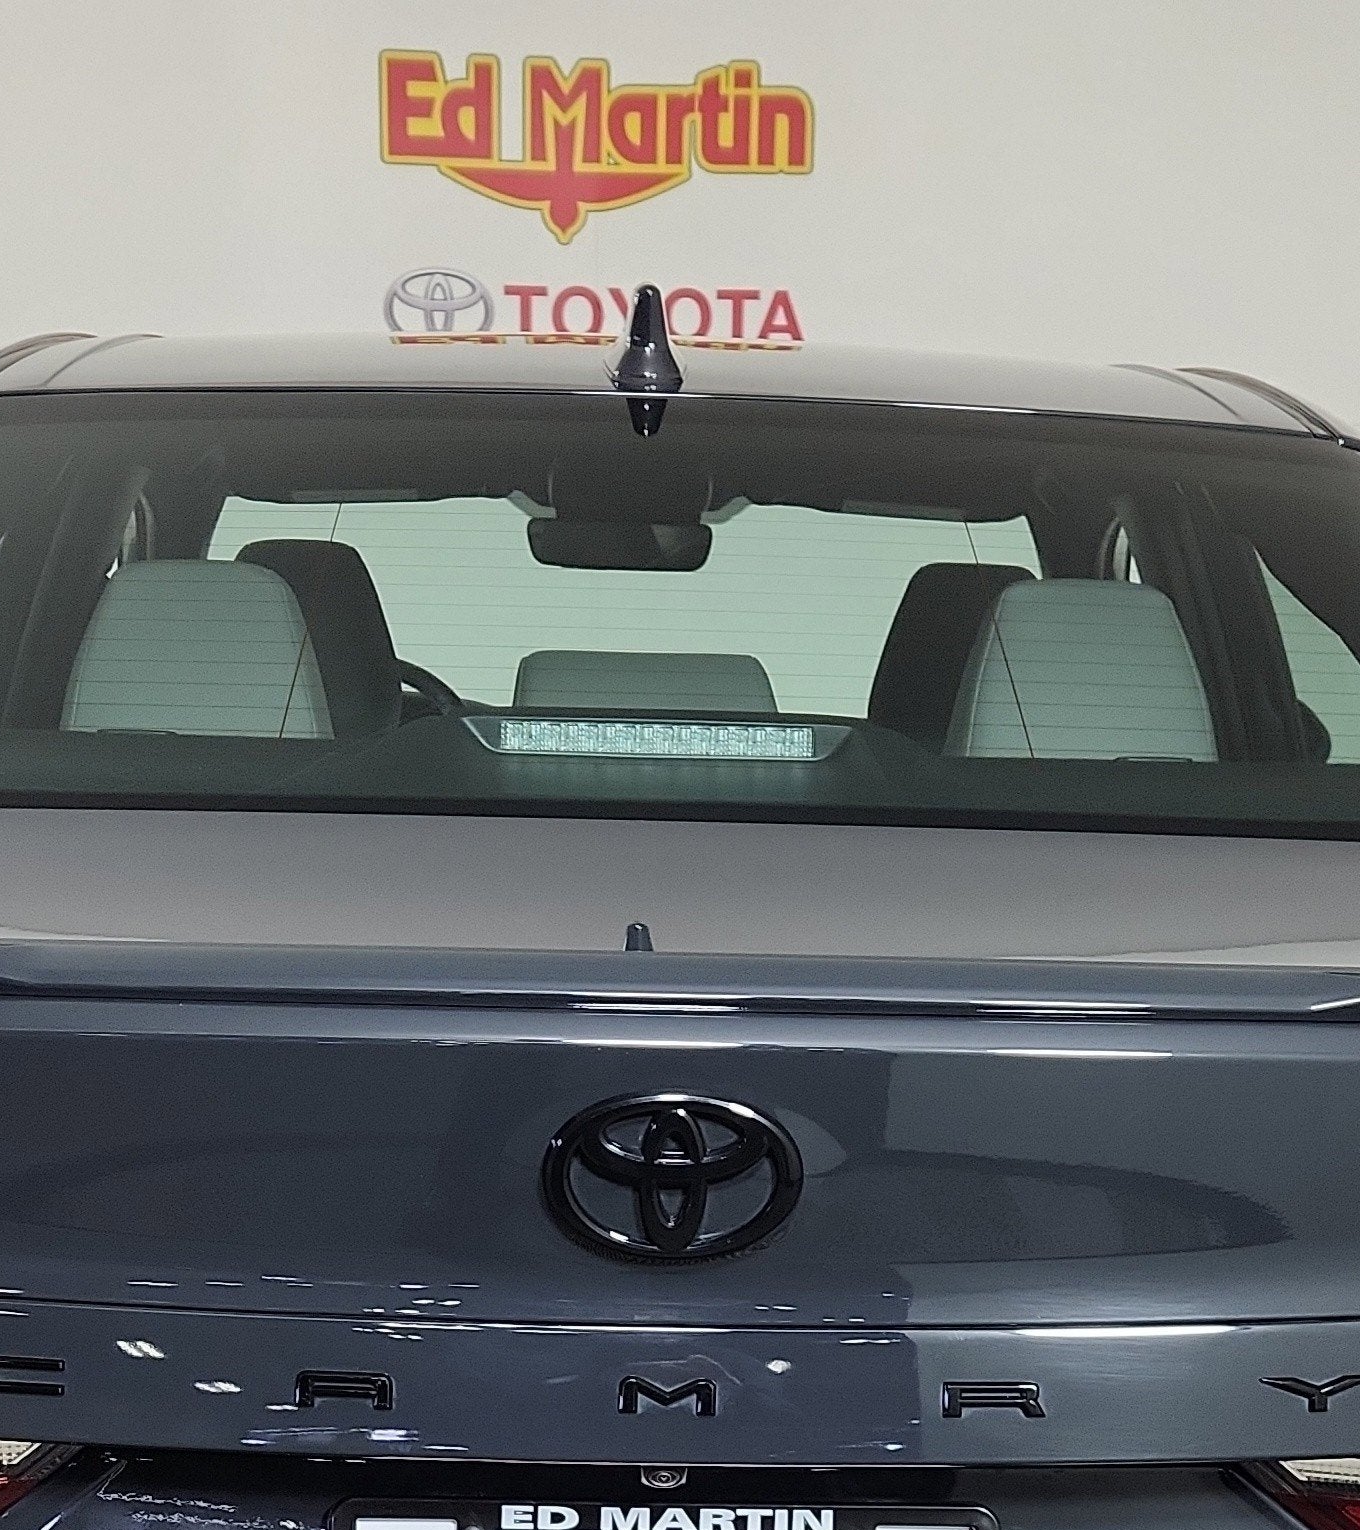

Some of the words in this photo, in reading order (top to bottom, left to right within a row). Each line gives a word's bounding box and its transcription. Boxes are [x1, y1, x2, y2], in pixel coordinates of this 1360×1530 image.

[380, 48, 499, 165] Ed
[524, 55, 813, 174] Martin
[504, 283, 804, 341] TOOTA
[500, 1506, 580, 1530] ED
